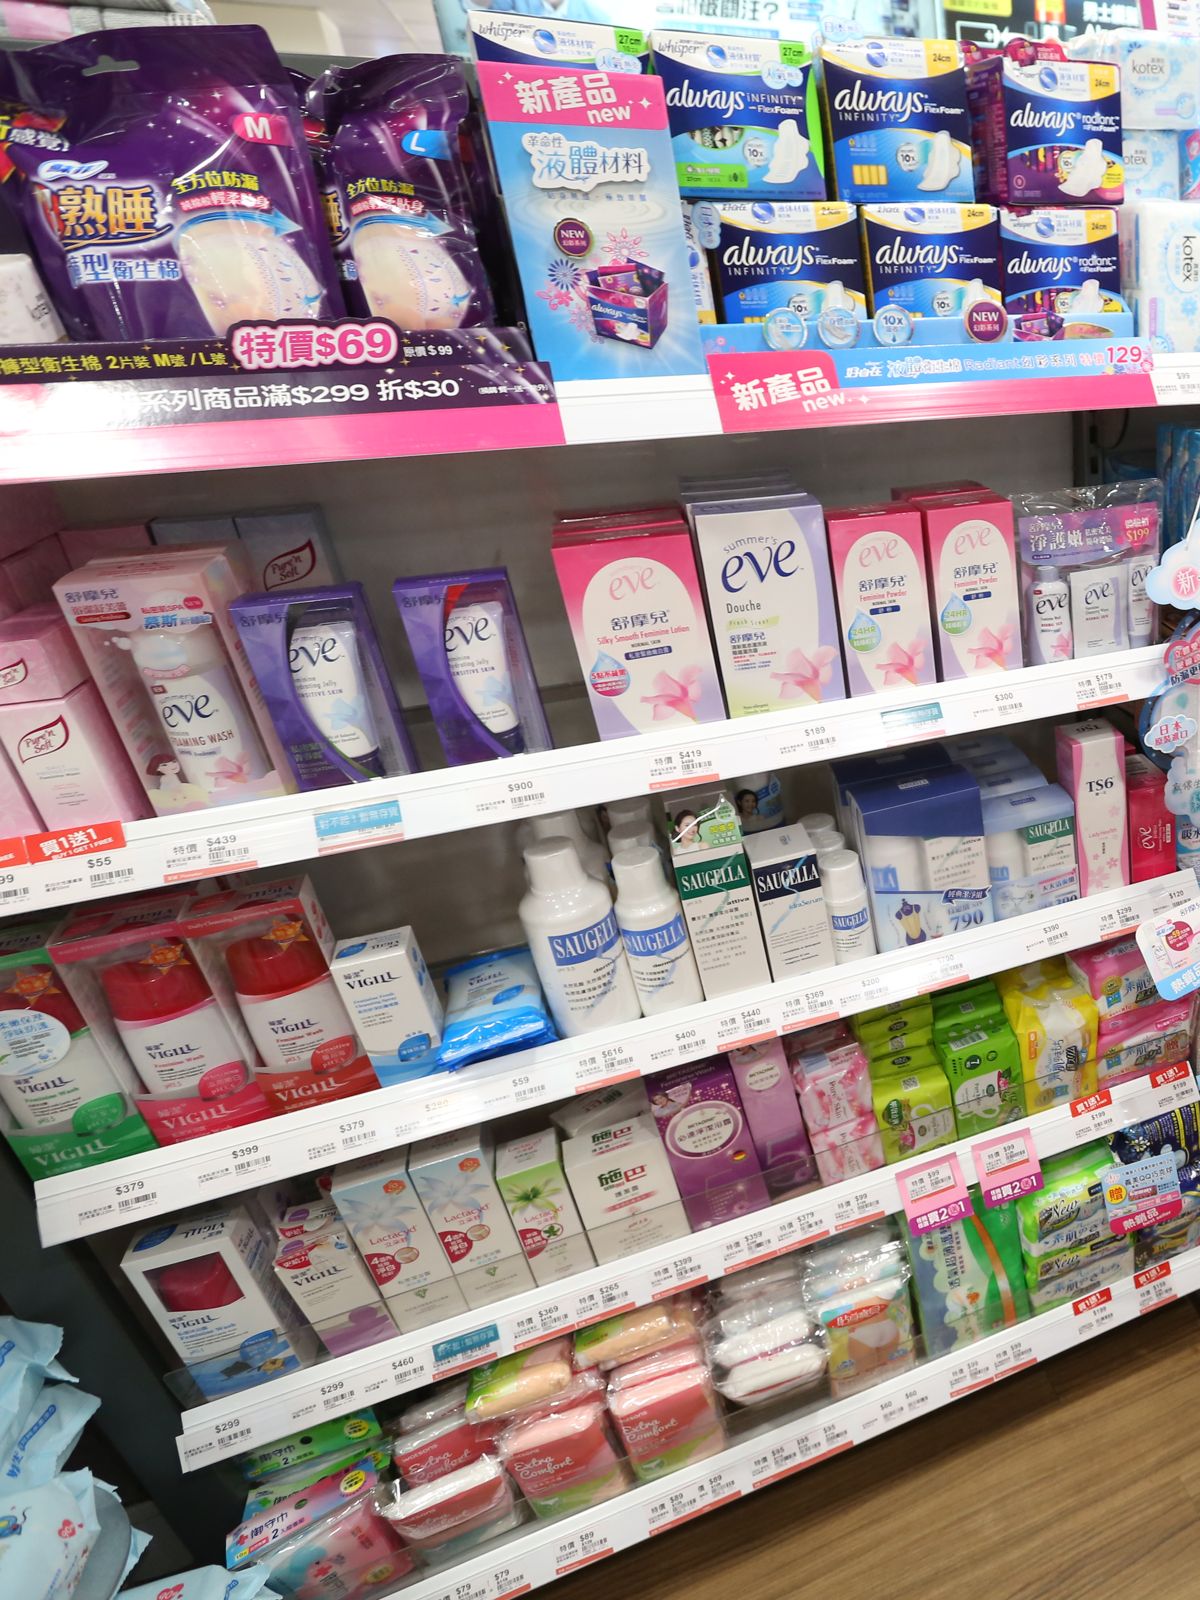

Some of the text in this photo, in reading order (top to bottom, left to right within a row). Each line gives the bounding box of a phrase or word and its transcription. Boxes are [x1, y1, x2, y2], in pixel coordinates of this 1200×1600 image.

[1132, 61, 1165, 75] kotex
[514, 73, 617, 114] 新產品
[666, 80, 744, 118] always
[834, 80, 923, 122] always
[587, 105, 631, 124] new
[1010, 103, 1076, 136] always
[245, 116, 272, 141] M
[411, 135, 426, 152] L
[527, 136, 562, 148] 革命性
[537, 145, 642, 181] 液體材料
[172, 171, 259, 195] 全方位防漏
[57, 185, 156, 238] 熟睡
[561, 230, 585, 240] NEW
[723, 236, 816, 275] always
[875, 236, 958, 274] always
[1183, 236, 1195, 282] kotex
[1007, 251, 1072, 280] always
[882, 316, 904, 326] 10x
[972, 312, 999, 322] NEW
[240, 329, 393, 365] 特價$69
[1107, 346, 1142, 364] 129
[377, 379, 459, 401] 折$30
[730, 367, 830, 412] 新產品
[803, 393, 846, 413] new
[723, 536, 777, 554] summer's
[954, 526, 992, 556] eve
[859, 539, 899, 567] eve
[721, 540, 799, 593] eve
[953, 562, 997, 579] 舒摩兒
[608, 566, 658, 600] eve
[858, 576, 905, 592] 舒摩兒
[978, 576, 998, 586] Powder
[860, 589, 907, 602] Feminine Powder
[1085, 582, 1110, 605] eve
[727, 601, 762, 614] Douche
[1036, 593, 1067, 614] eve
[610, 611, 669, 632] 舒摩兒
[444, 617, 489, 652] eve
[597, 625, 690, 646] Silky Smooth Feminine Lotion
[730, 632, 766, 644] 舒摩兒
[288, 637, 341, 673] eve
[1095, 673, 1113, 682] $179
[995, 692, 1014, 701] $300
[162, 694, 216, 728] eve
[210, 729, 234, 744] WASH
[804, 726, 826, 737] $189
[679, 749, 702, 760] $419
[508, 781, 533, 792] $900
[1087, 777, 1114, 793] TS6
[1027, 817, 1071, 840] SAUGELLA
[39, 828, 98, 857] 買1送1
[206, 834, 237, 847] $439
[87, 857, 112, 869] $55
[681, 866, 745, 892] SAUGELLA
[757, 864, 819, 893] SAUGELLA
[832, 911, 868, 931] SAUGELLA
[951, 909, 985, 933] 790
[553, 917, 616, 959] SAUGELL
[626, 919, 685, 952] SAUGELLA
[346, 971, 402, 990] VIGILL
[805, 990, 825, 1000] $369
[741, 1009, 761, 1019] $440
[271, 1019, 319, 1036] VIGILL
[676, 1030, 696, 1041] $400
[147, 1044, 201, 1061] VIGILL
[601, 1046, 624, 1058] $616
[17, 1077, 76, 1095] VIGILL
[275, 1077, 347, 1102] VIGILL
[512, 1076, 530, 1087] $59
[1076, 1094, 1101, 1114] 買1送1
[161, 1105, 240, 1130] VIGILL
[339, 1120, 365, 1133] $379
[33, 1138, 119, 1167] VIGILL
[232, 1145, 259, 1159] $399
[115, 1181, 145, 1195] $379
[1110, 1187, 1122, 1203] 贈
[444, 1202, 491, 1224] Lactacyd
[797, 1212, 815, 1222] $379
[369, 1226, 417, 1246] Lactacyd
[673, 1257, 693, 1268] $399
[294, 1266, 344, 1286] VIGILL
[599, 1283, 620, 1295] $265
[538, 1306, 559, 1318] $369
[172, 1315, 219, 1330] VIGILL
[392, 1357, 414, 1370] $460
[321, 1382, 344, 1395] $299
[215, 1419, 240, 1433] $299
[622, 1418, 661, 1436] Extra
[626, 1418, 679, 1443] Comfort
[409, 1452, 452, 1475] Extra
[514, 1455, 555, 1473] Extra
[519, 1456, 575, 1480] Comfort
[580, 1531, 594, 1542] $89
[494, 1569, 510, 1581] $79
[456, 1583, 471, 1595] $79
